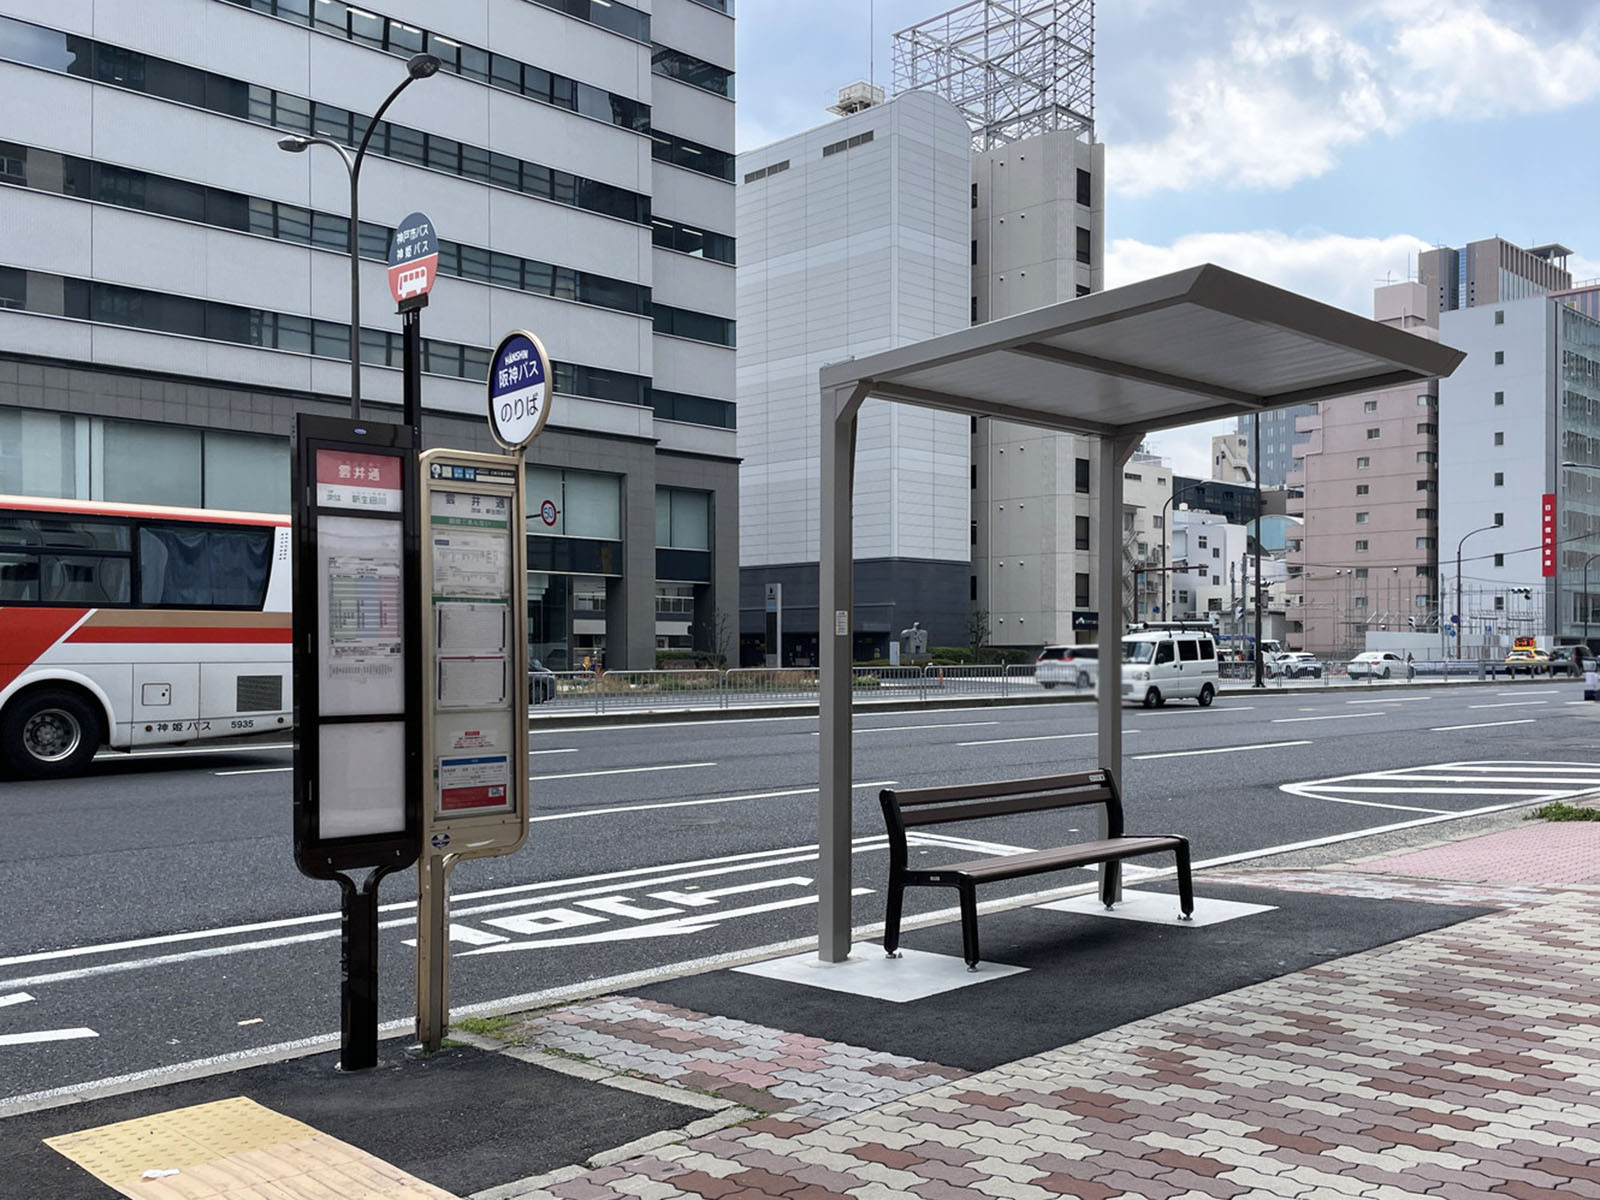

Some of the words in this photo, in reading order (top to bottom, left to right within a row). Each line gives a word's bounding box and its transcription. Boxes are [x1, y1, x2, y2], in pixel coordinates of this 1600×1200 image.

[396, 223, 429, 245] 神戸市バス
[396, 240, 429, 261] 神姫バス
[504, 349, 529, 366] HANSHIN
[498, 360, 539, 389] 阪神バス
[501, 392, 539, 423] のりば
[157, 721, 212, 733] 神姫バス
[231, 720, 254, 729] 5935
